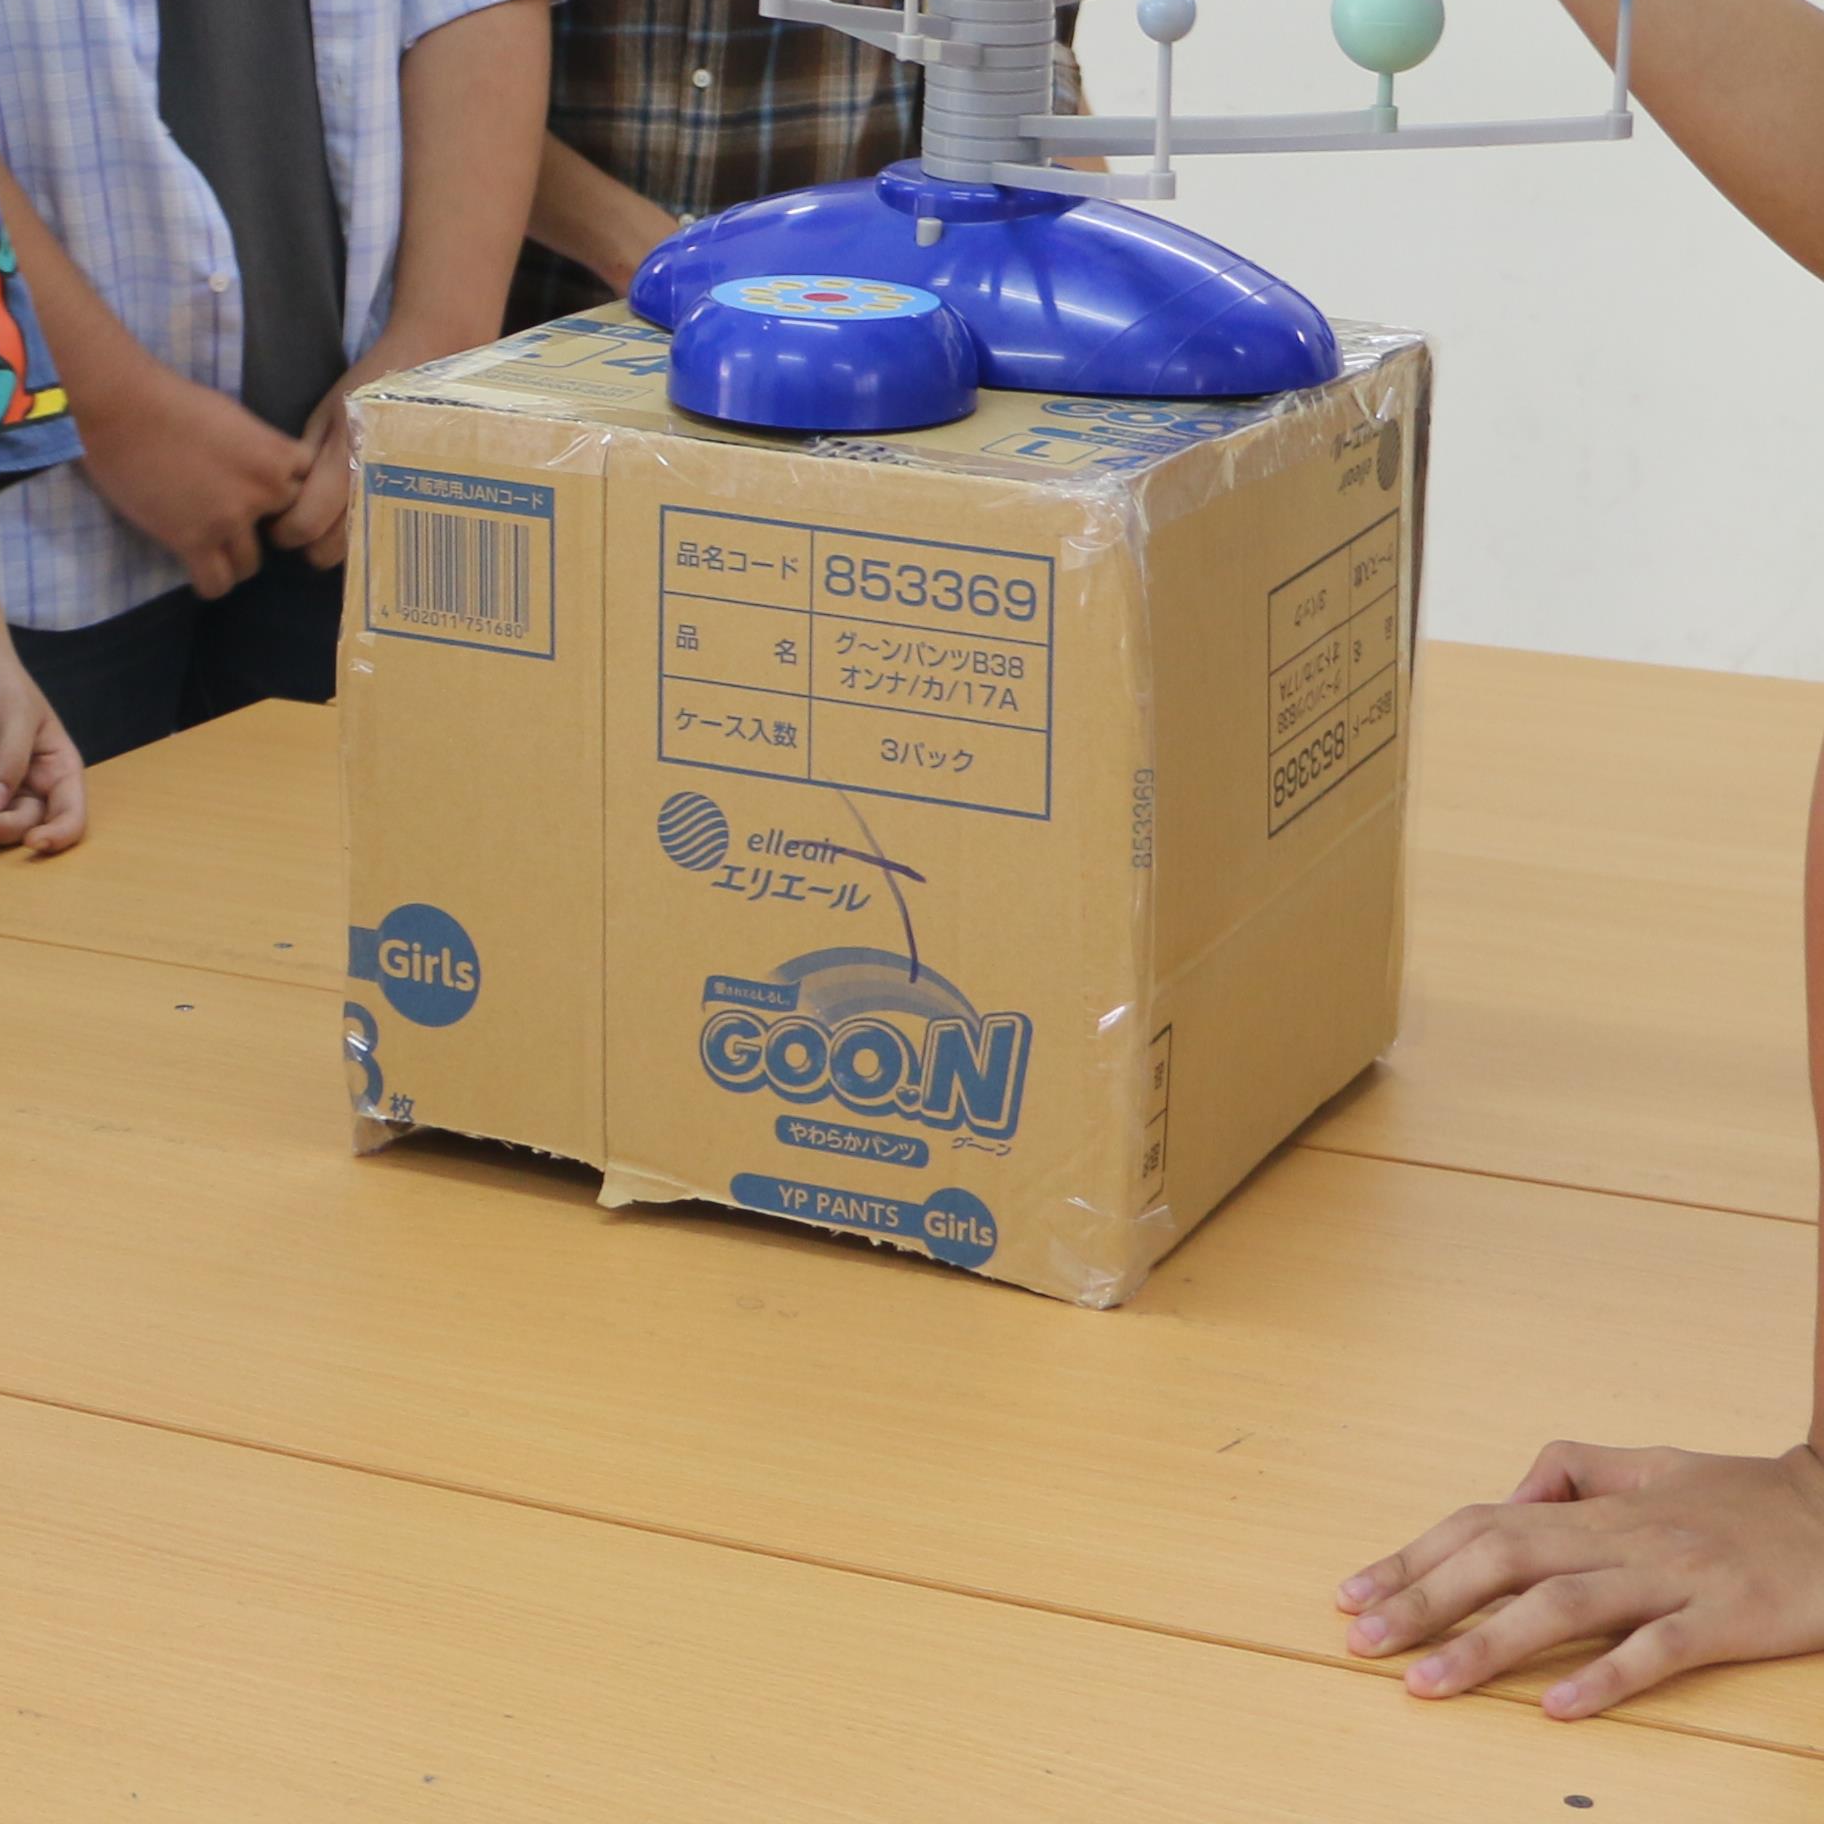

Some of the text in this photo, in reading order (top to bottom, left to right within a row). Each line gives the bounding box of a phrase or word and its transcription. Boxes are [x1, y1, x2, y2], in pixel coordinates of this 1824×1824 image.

[1015, 440, 1052, 458] L
[375, 471, 544, 510] ケース販売用JANコード
[676, 541, 799, 580] 品名コード
[824, 554, 1038, 622] 853369
[380, 605, 524, 639] 4 902011 751680
[675, 707, 797, 749] ケース入数
[880, 738, 975, 773] 3パック
[1273, 720, 1345, 808] 853368
[1132, 768, 1154, 871] 853369
[747, 828, 840, 864] elleair
[711, 864, 871, 912] エリエール
[379, 939, 475, 992] Girls
[789, 1122, 916, 1160] やわらかパンツ
[778, 1184, 994, 1247] YP PANTS Girls
